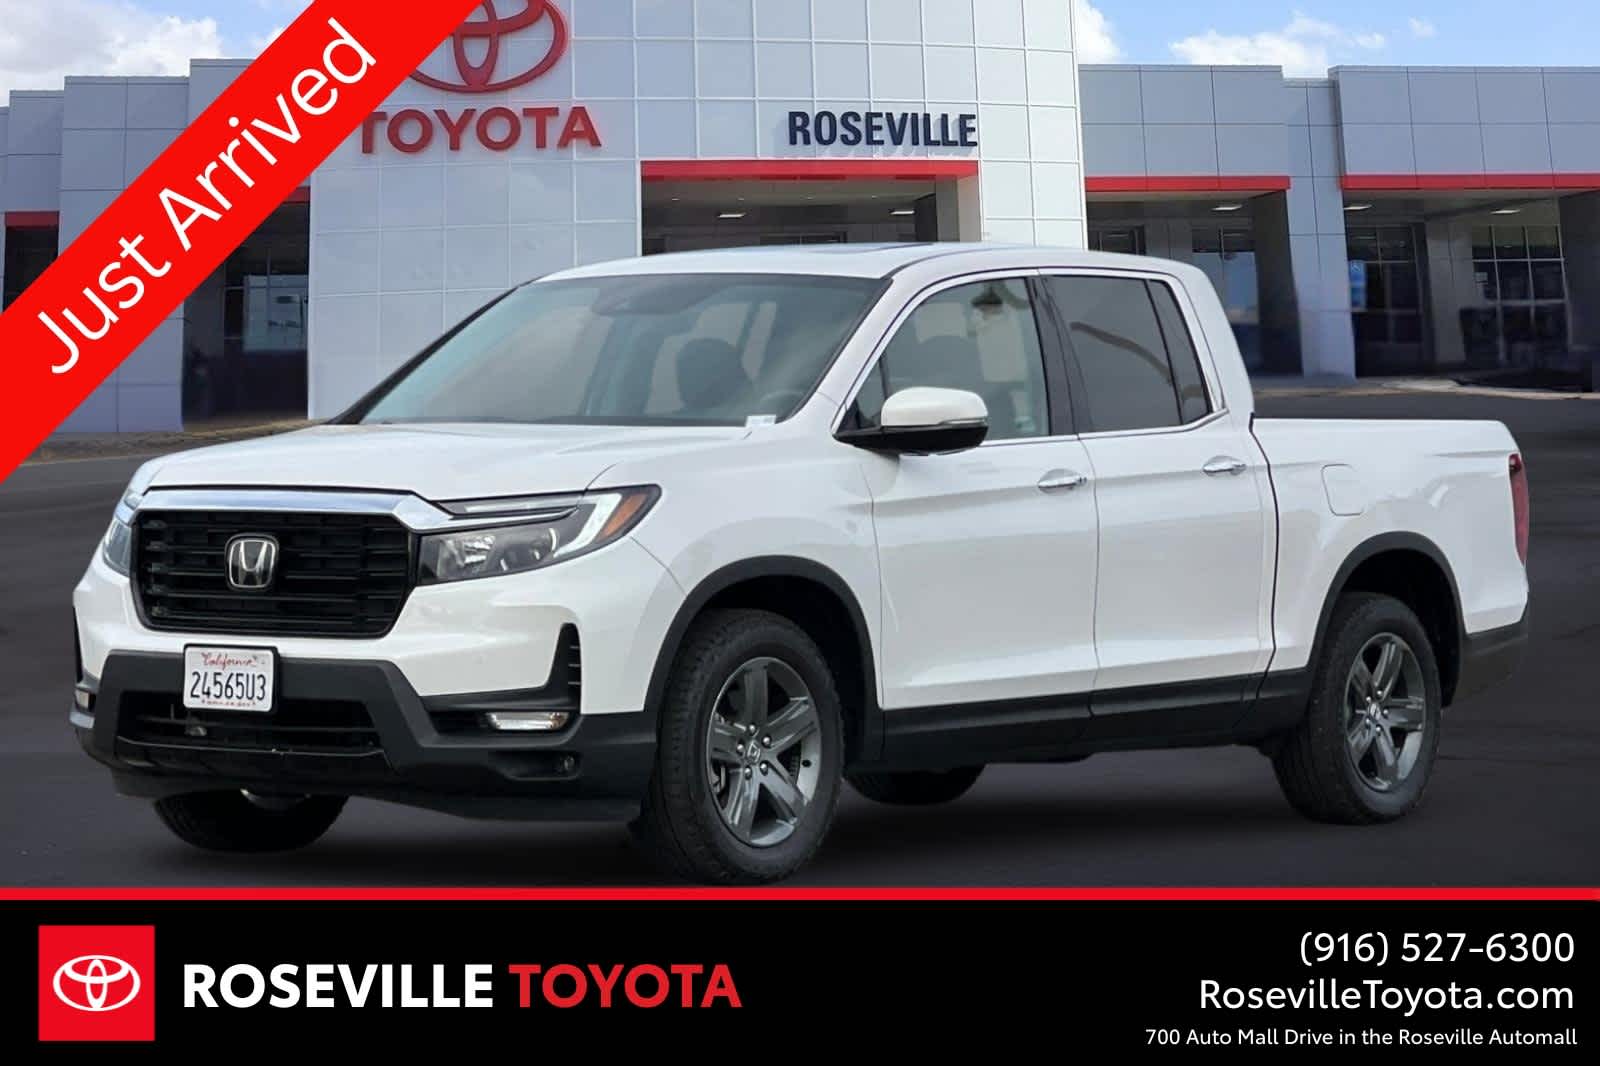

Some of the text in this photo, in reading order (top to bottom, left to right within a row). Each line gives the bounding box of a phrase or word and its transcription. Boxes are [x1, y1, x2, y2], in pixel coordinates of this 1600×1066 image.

[361, 106, 602, 154] TOYOTA
[788, 110, 978, 147] ROSEVILLE
[201, 651, 258, 670] California
[190, 671, 266, 701] 24565U3
